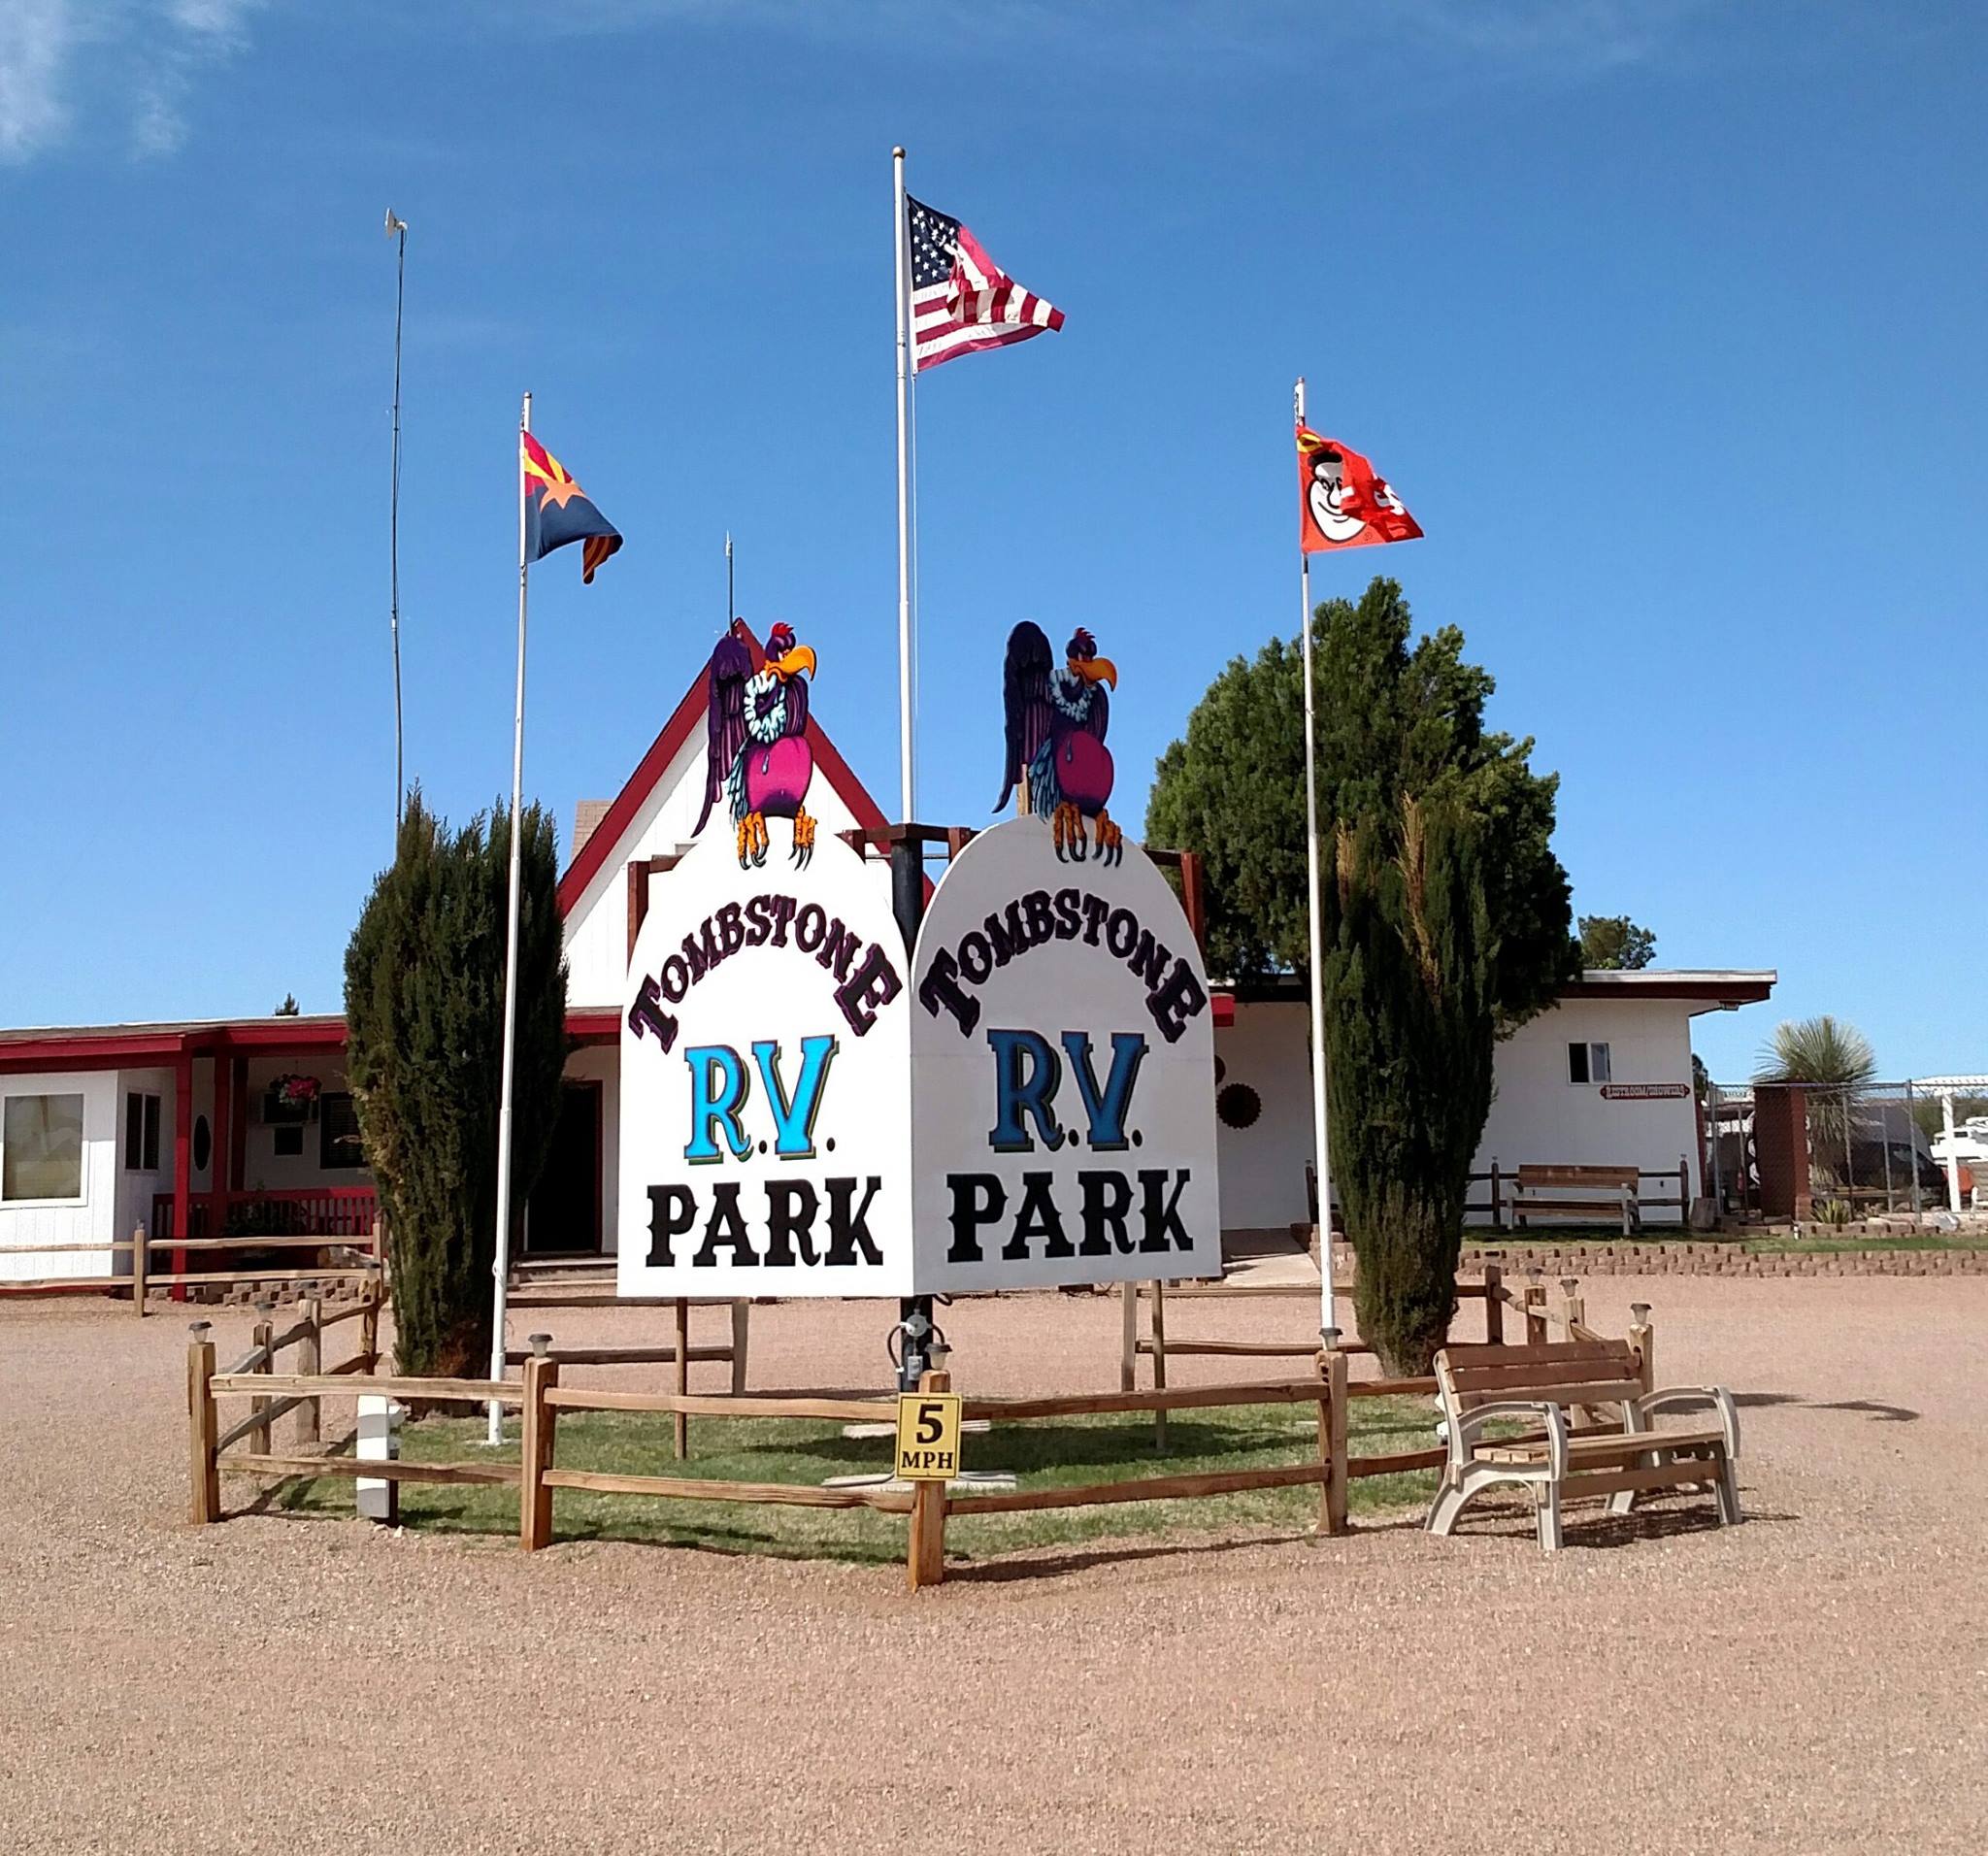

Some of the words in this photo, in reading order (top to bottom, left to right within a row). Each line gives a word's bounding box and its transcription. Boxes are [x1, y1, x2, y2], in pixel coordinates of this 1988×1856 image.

[627, 894, 904, 1055] TOMBSTONE
[918, 888, 1208, 1044] TOMBSTONE
[683, 1034, 840, 1165] R.V.
[986, 1027, 1150, 1153] R.V.
[646, 1176, 883, 1268] PARK
[946, 1168, 1194, 1264] PARK
[901, 1450, 954, 1470] MPH
[915, 1404, 944, 1444] 5
